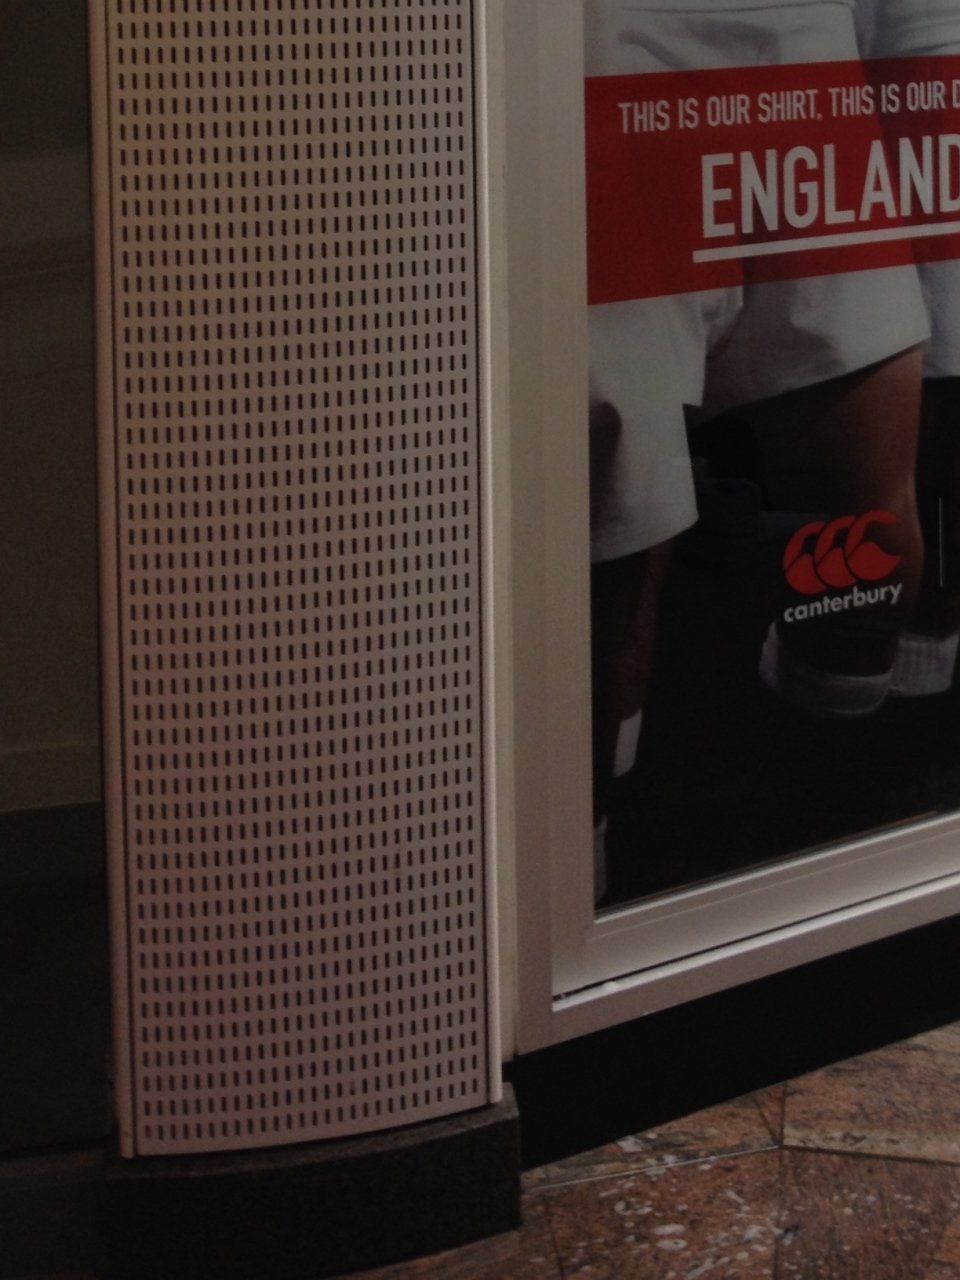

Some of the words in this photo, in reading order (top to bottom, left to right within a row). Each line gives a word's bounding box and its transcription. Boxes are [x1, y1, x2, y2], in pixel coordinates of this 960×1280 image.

[617, 100, 670, 134] THIS
[678, 97, 699, 129] IS
[706, 94, 751, 127] OUR
[828, 85, 875, 117] THIS
[881, 83, 900, 114] IS
[906, 80, 946, 112] OUR
[783, 582, 902, 623] canterbury
